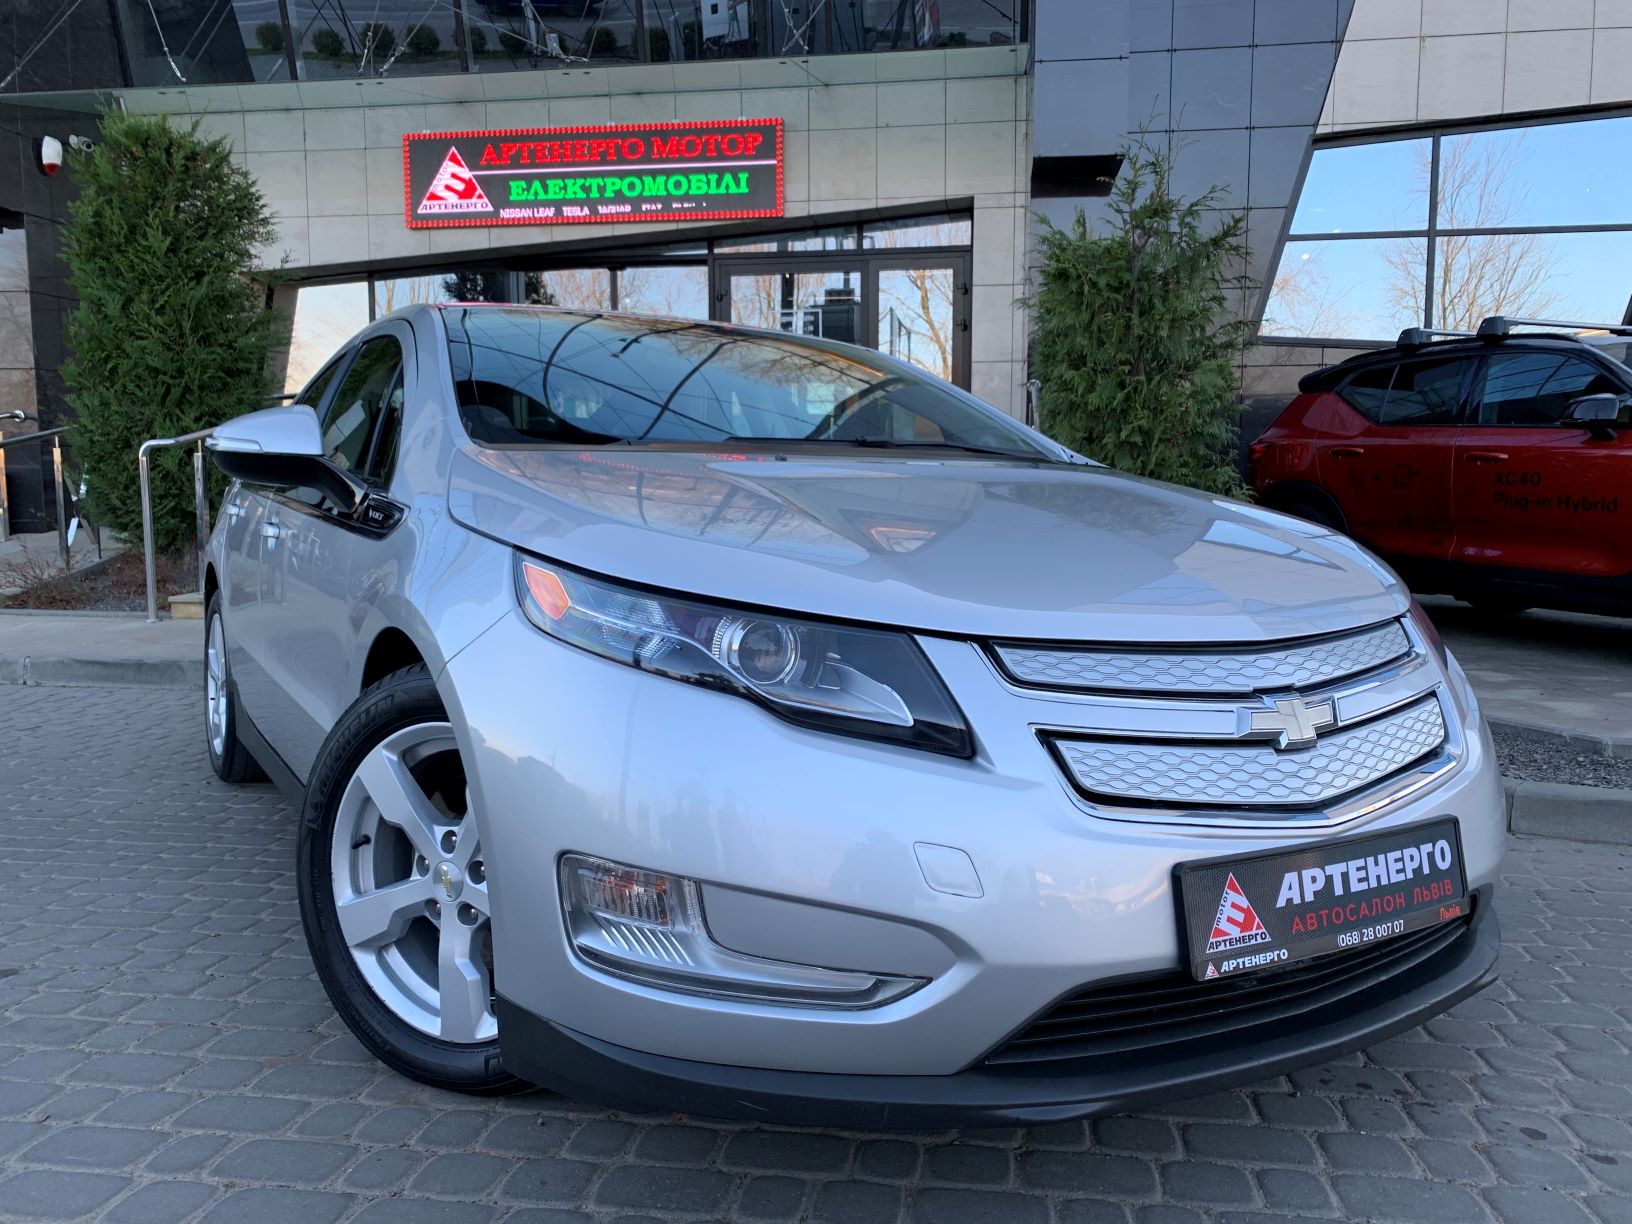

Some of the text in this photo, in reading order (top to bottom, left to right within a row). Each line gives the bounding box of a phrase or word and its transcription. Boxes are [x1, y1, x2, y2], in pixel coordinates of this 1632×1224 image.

[480, 133, 763, 165] АРТЕНЕРГО МОТОР
[509, 172, 749, 201] ЕЛЕКТРОМОБІЛІ
[420, 202, 489, 212] АРТЕНЕРГО
[500, 208, 533, 219] NISSAN
[534, 207, 556, 217] LEAF
[563, 206, 590, 217] TESLA
[1496, 471, 1541, 487] XC40
[1493, 492, 1619, 513] Plug-in Hybrid
[1276, 839, 1452, 908] АРТЕНЕРГО
[1215, 890, 1230, 927] motor
[1291, 879, 1454, 934] АВТОСАЛОН ЛЬВІВ
[1439, 903, 1463, 921] Львів
[1207, 932, 1268, 952] АРТЕНЕРГО
[1337, 920, 1404, 947] (068) 28 007 07
[1221, 948, 1289, 973] АРТЕНЕРГО
